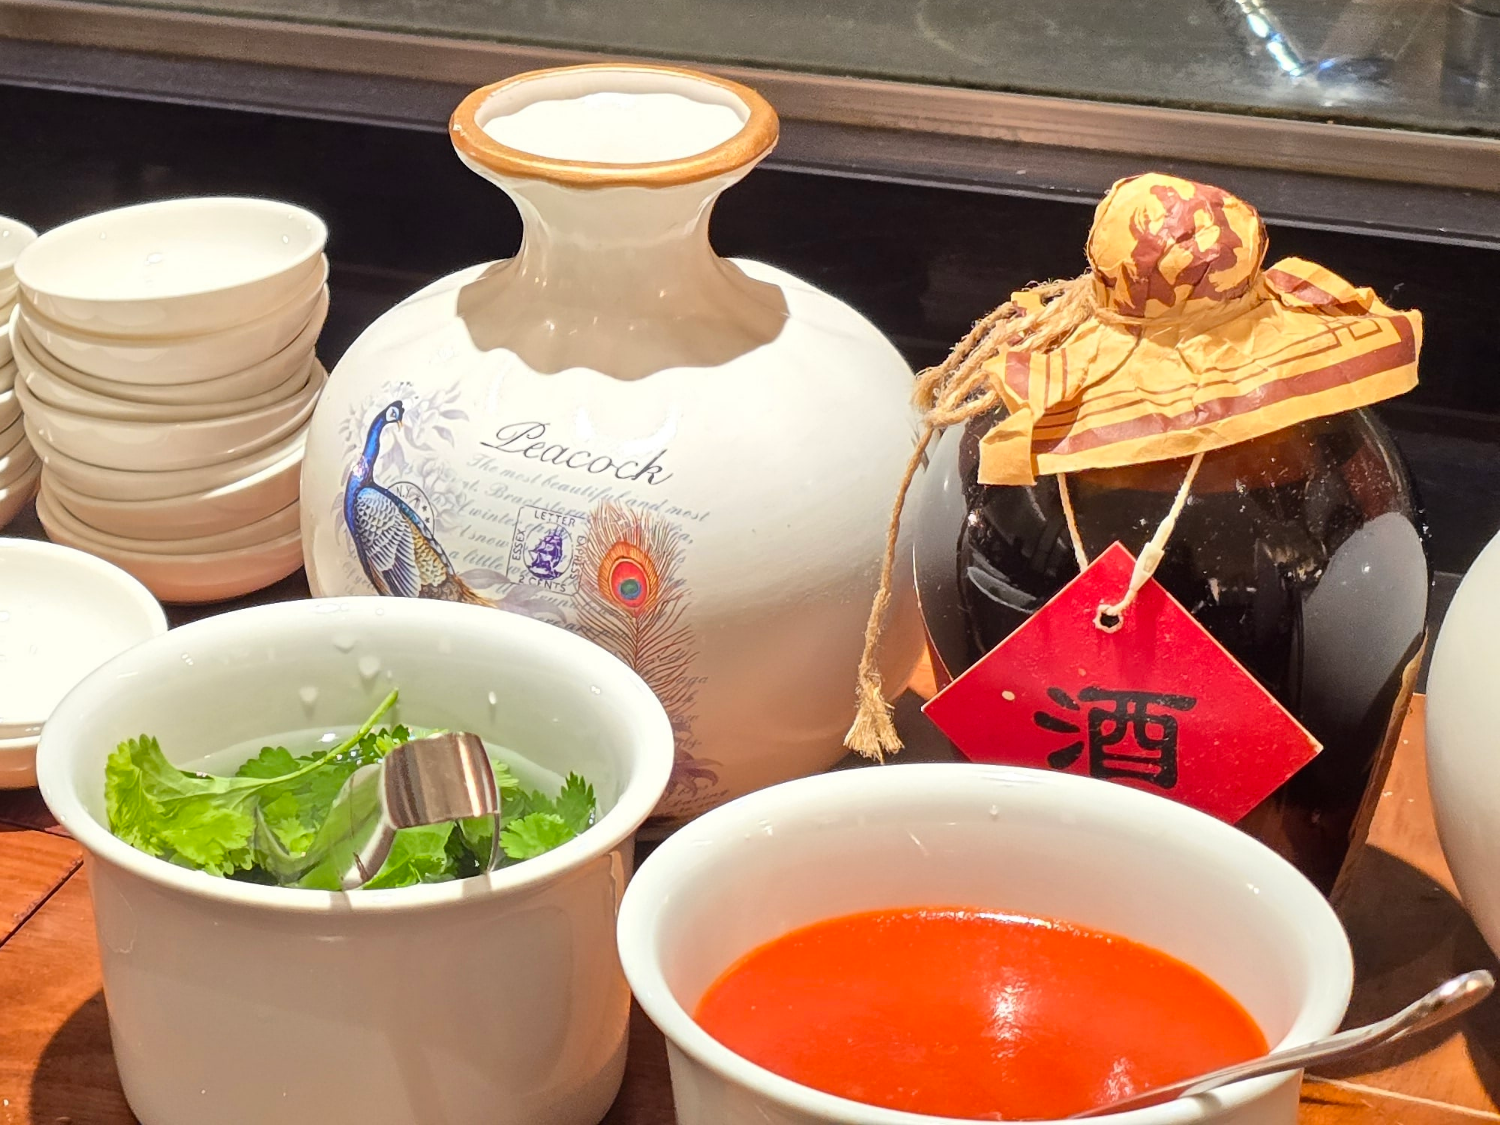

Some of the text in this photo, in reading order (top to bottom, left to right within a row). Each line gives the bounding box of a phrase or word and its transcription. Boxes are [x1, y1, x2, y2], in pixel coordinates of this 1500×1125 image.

[466, 453, 499, 475] The
[480, 421, 674, 486] Peacock
[534, 510, 576, 527] LETTER
[512, 528, 526, 561] ESSEX
[569, 535, 587, 579] EXPRESS
[518, 576, 566, 592] 2 CENTS
[1033, 686, 1198, 791] 酒
